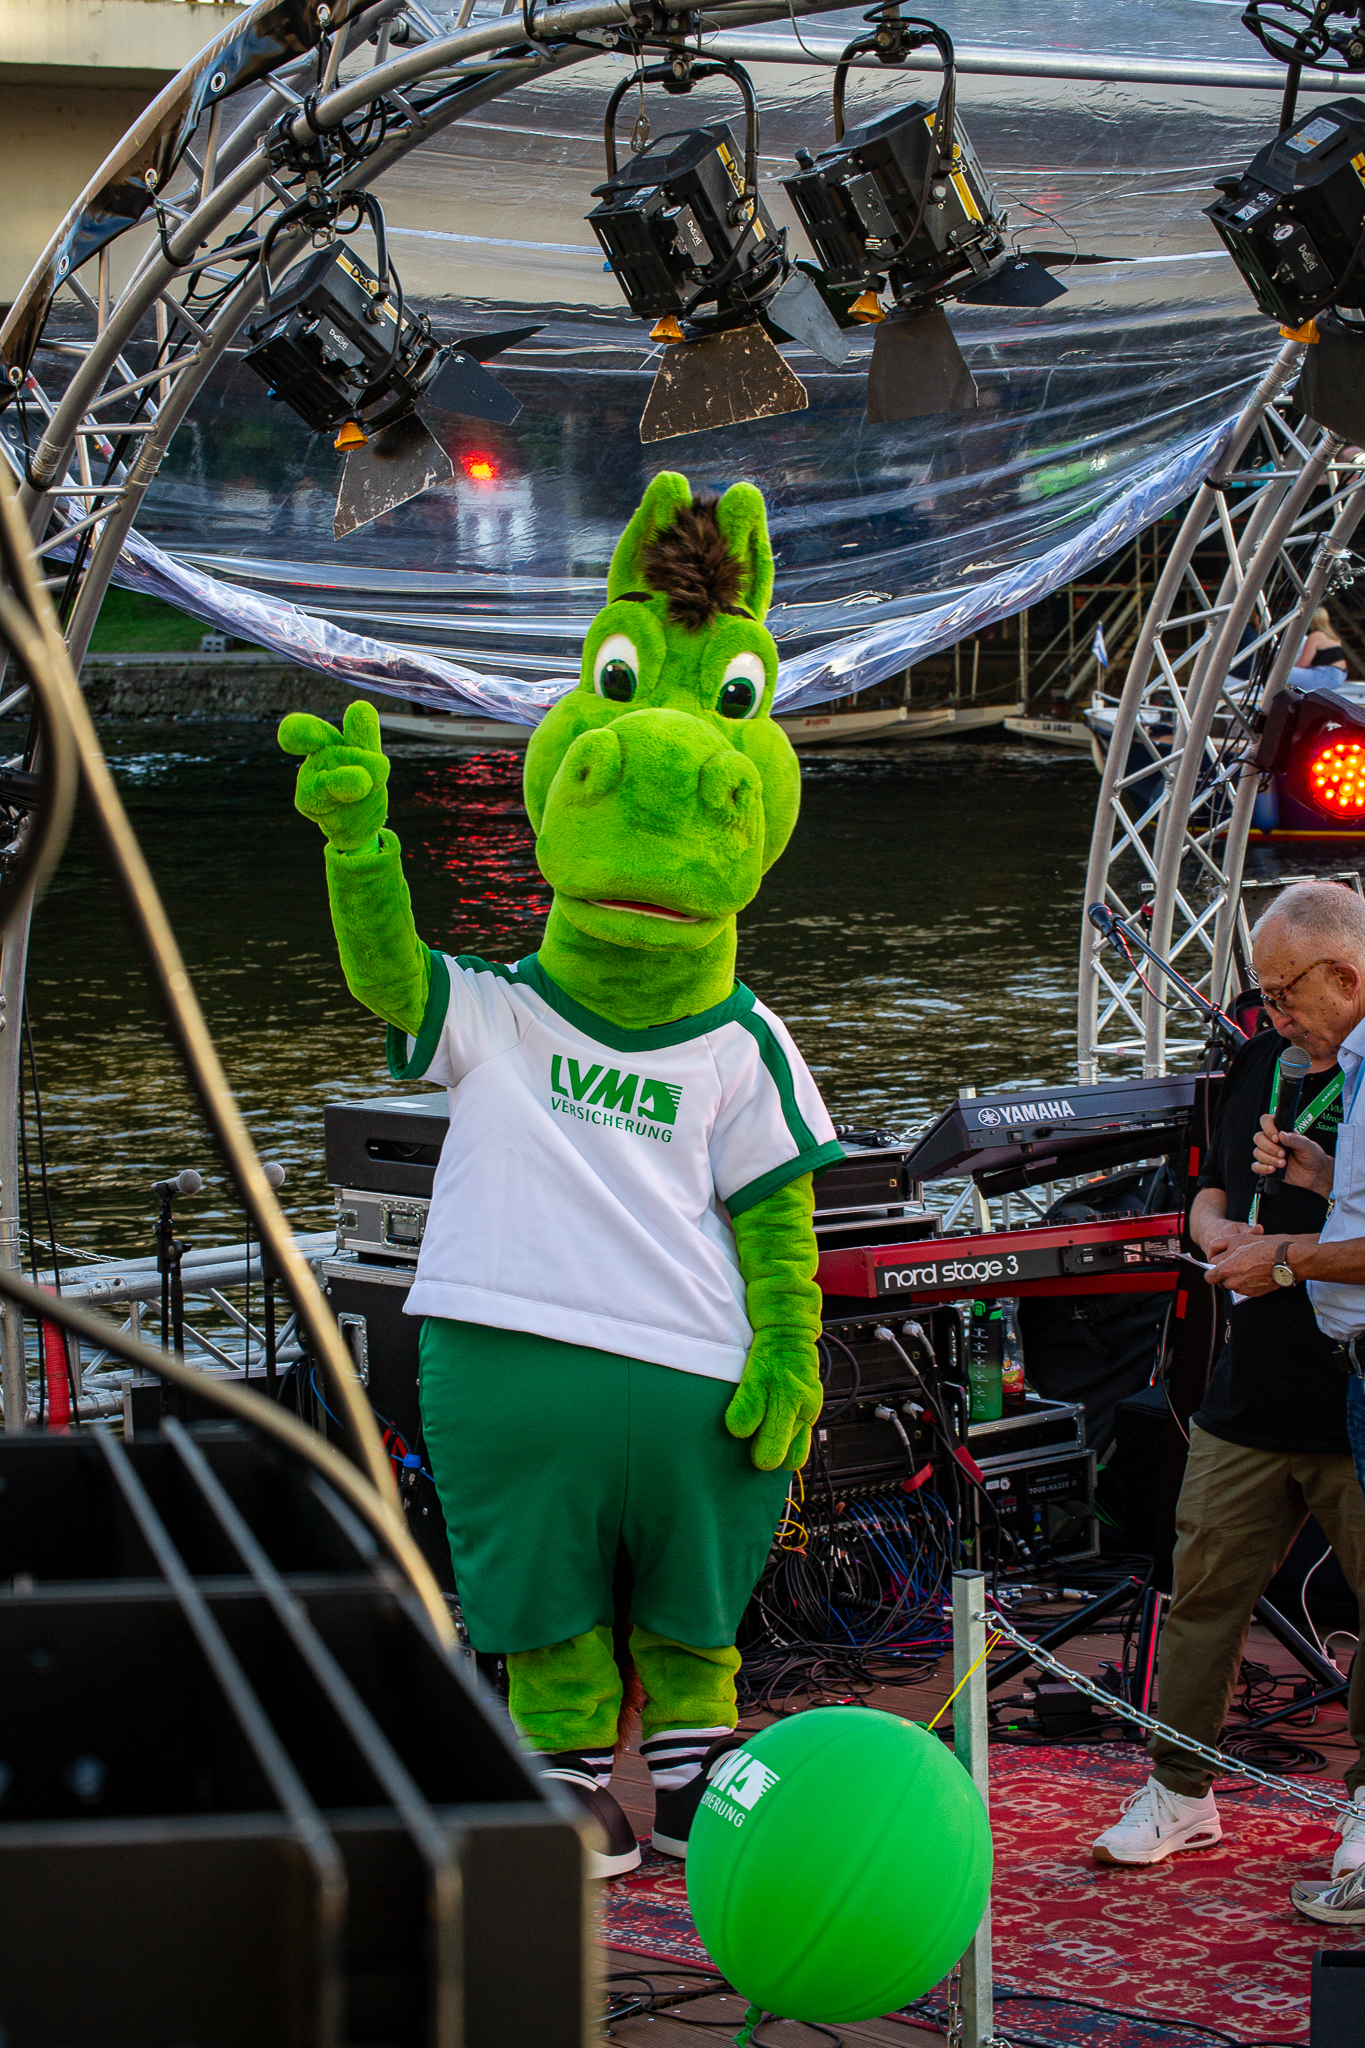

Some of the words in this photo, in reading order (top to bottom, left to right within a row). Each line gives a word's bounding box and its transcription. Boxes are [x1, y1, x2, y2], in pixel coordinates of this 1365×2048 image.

[551, 1053, 640, 1114] LVM
[551, 1096, 673, 1143] VERSICHERUNG
[999, 1100, 1076, 1124] YAMAHA
[1315, 1121, 1338, 1133] Saarb
[884, 1263, 938, 1289] nord
[941, 1261, 1003, 1282] stage
[1006, 1254, 1019, 1275] 3
